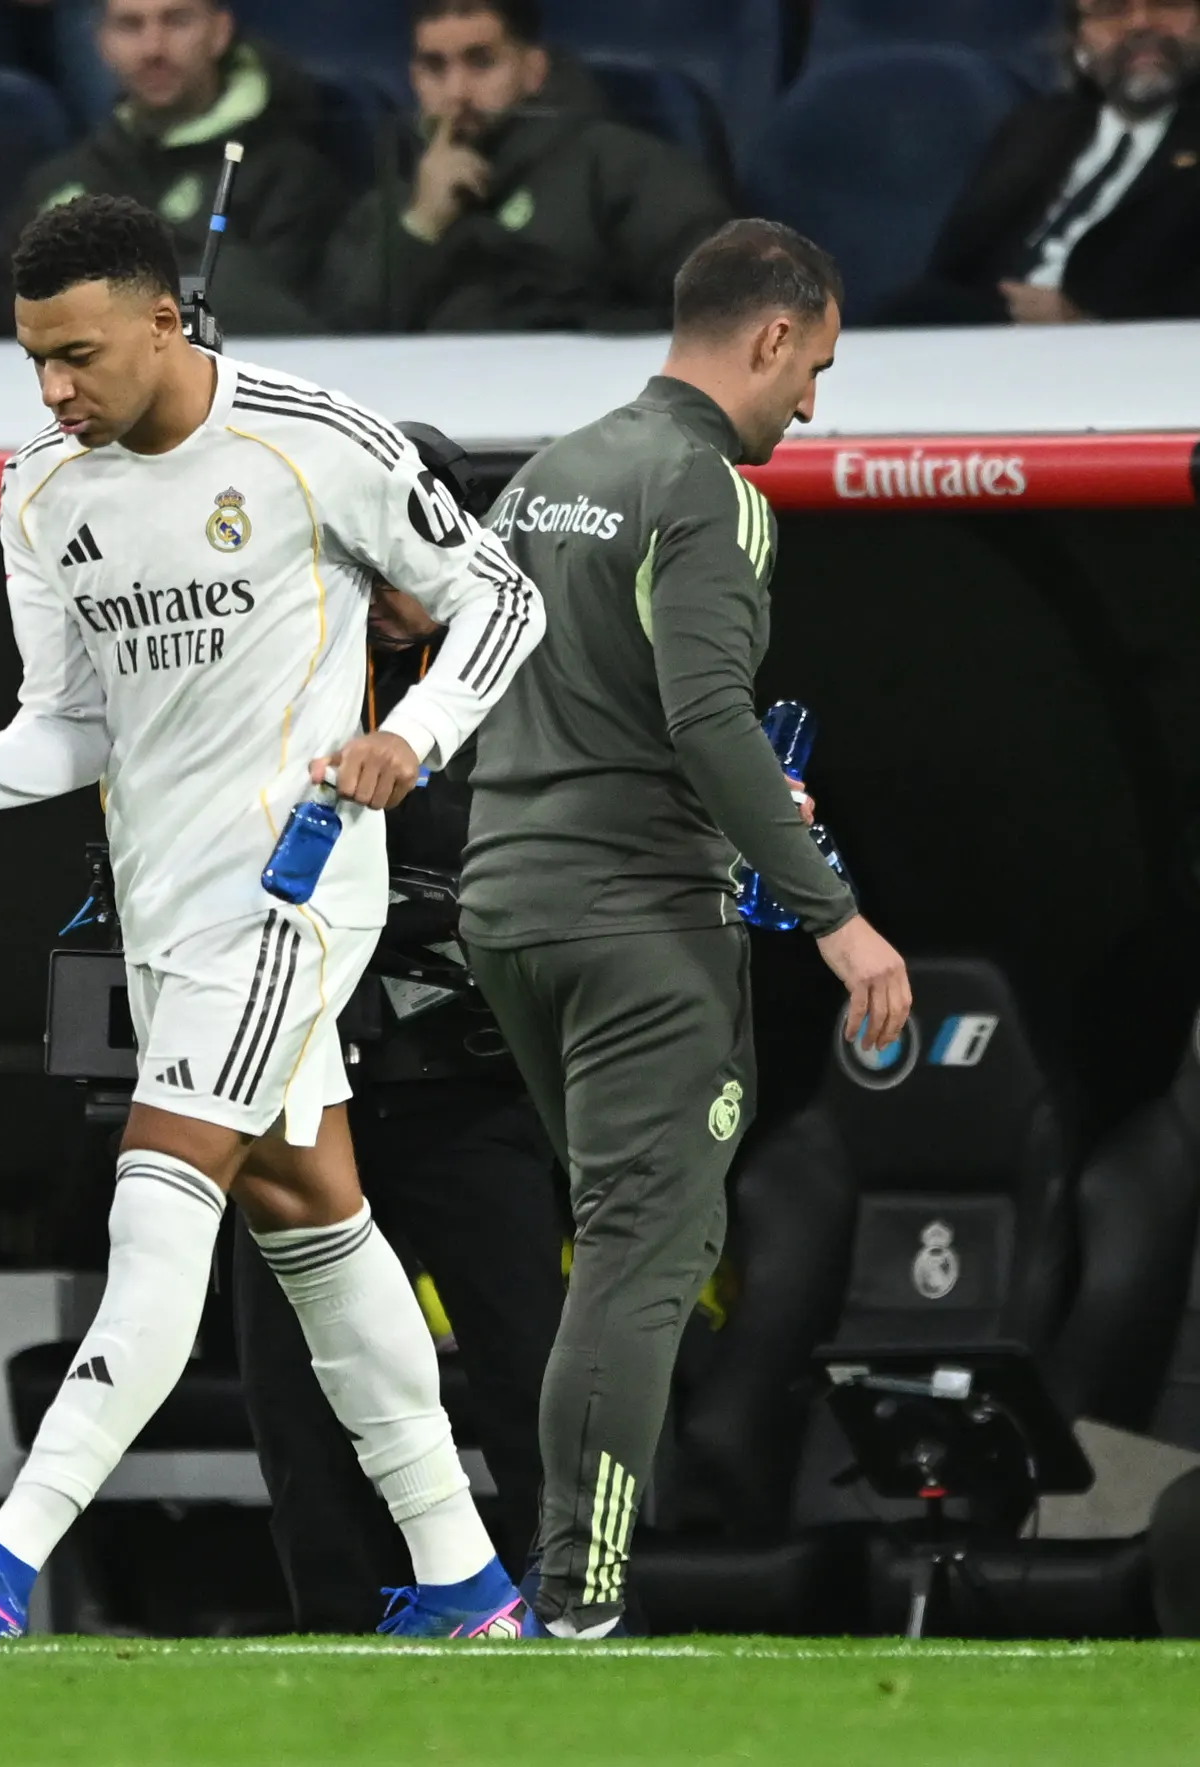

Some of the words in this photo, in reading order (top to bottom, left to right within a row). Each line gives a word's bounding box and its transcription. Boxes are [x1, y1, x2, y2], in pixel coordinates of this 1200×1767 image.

[834, 448, 1027, 498] Emirates
[516, 493, 624, 540] Sanitas
[74, 578, 255, 633] Emirates
[116, 638, 138, 676] LY
[147, 627, 225, 671] BETTER
